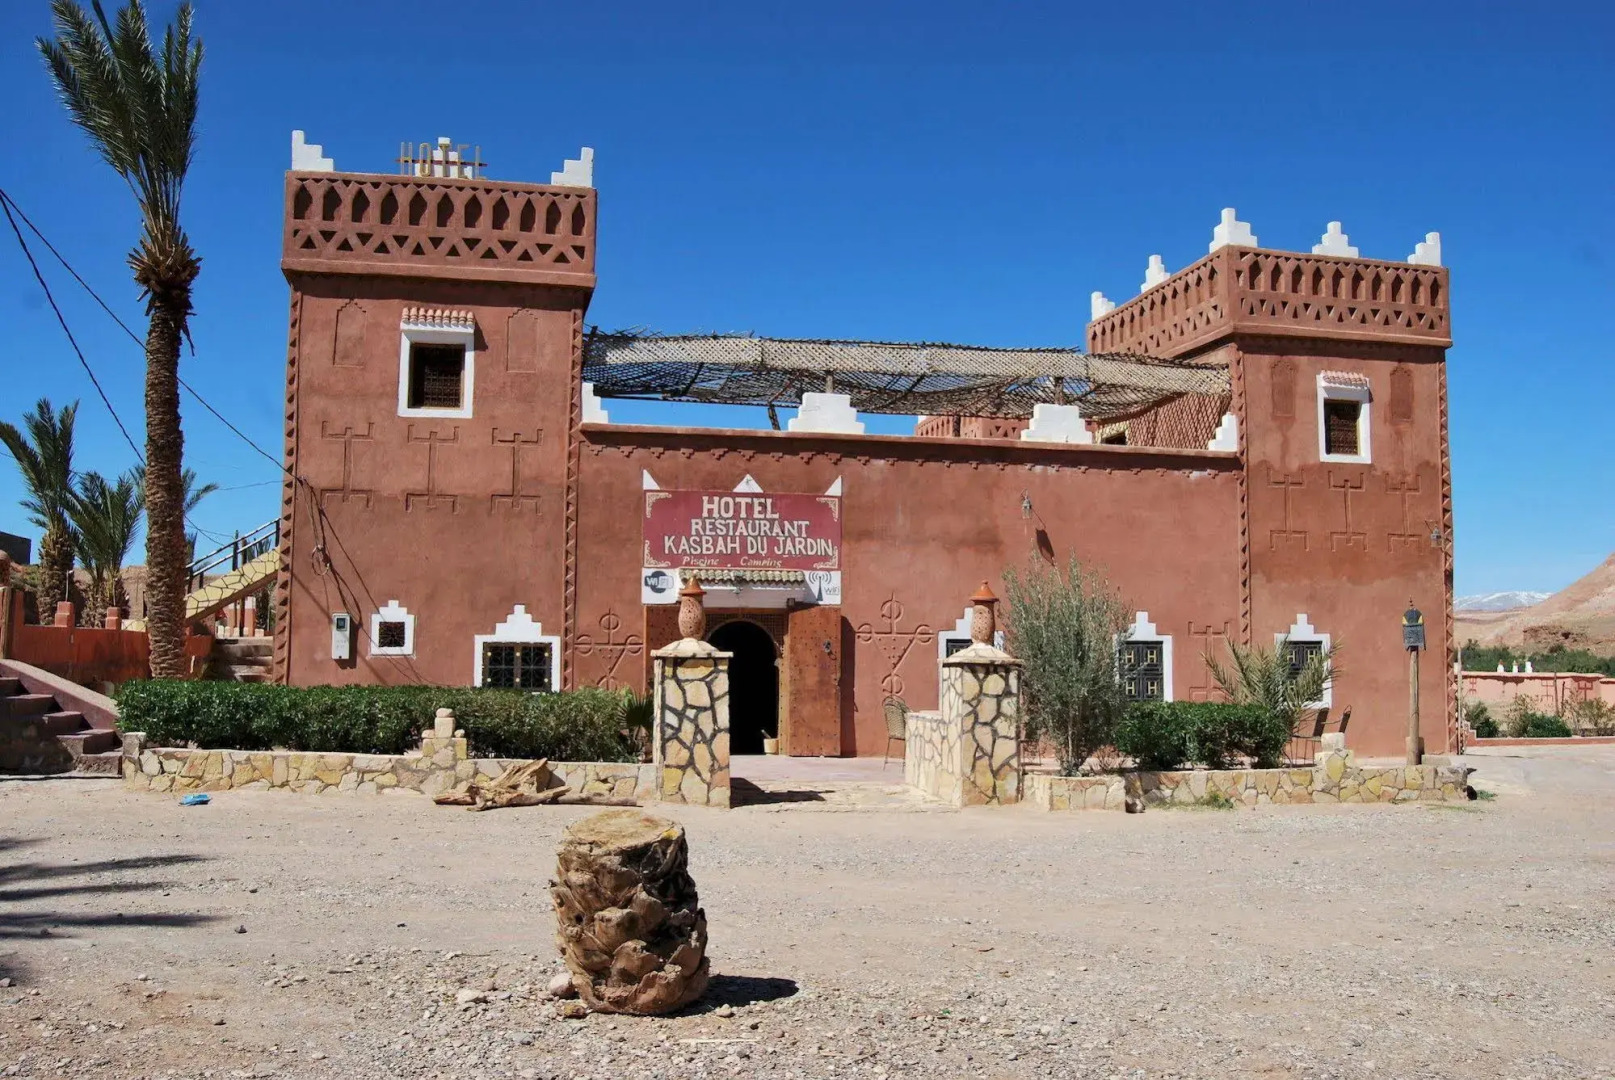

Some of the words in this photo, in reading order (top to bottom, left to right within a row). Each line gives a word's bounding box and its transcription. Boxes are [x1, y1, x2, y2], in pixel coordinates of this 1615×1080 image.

[400, 141, 487, 180] HOTEL
[702, 496, 780, 519] HOTEL
[691, 519, 810, 538] RESTAURANT
[664, 535, 740, 555] KASBAH
[747, 537, 768, 557] DU
[774, 536, 834, 557] JARDIN
[682, 556, 720, 567] Piscine
[740, 556, 783, 569] Camping
